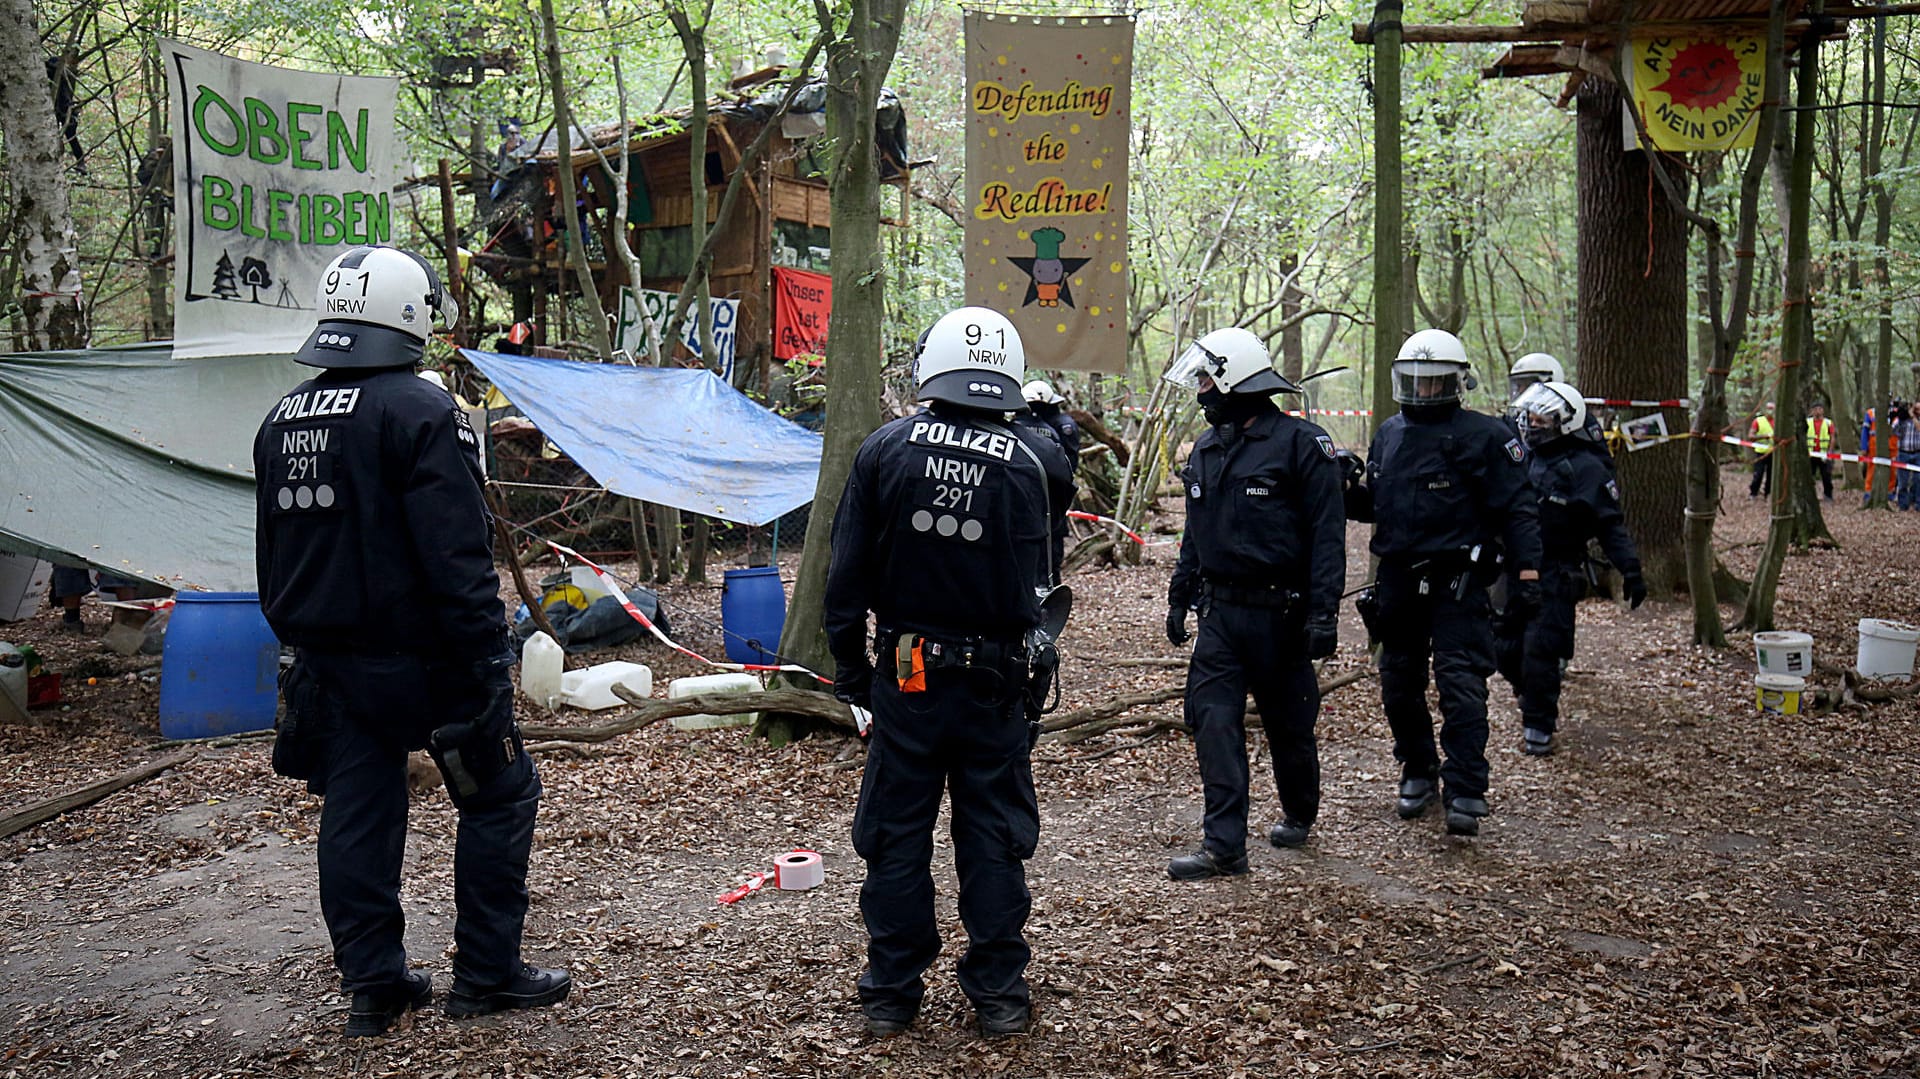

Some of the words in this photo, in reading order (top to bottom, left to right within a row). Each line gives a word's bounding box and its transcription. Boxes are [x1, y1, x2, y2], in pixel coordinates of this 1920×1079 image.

[976, 82, 1112, 121] Defending
[1656, 103, 1705, 139] NEIN
[1712, 73, 1761, 137] DANKE
[192, 84, 369, 173] OBEN
[1024, 134, 1065, 161] the
[202, 174, 391, 246] BLEIBEN
[982, 181, 1111, 220] Redline!
[785, 277, 825, 303] Unser
[326, 298, 366, 314] NRW
[798, 308, 820, 329] ist
[968, 348, 1007, 367] NRW
[272, 387, 361, 423] POLIZEI
[282, 428, 329, 454] NRW
[909, 421, 1017, 462] POLIZEI
[287, 455, 318, 480] 291
[925, 455, 987, 487] NRW
[933, 484, 974, 512] 291
